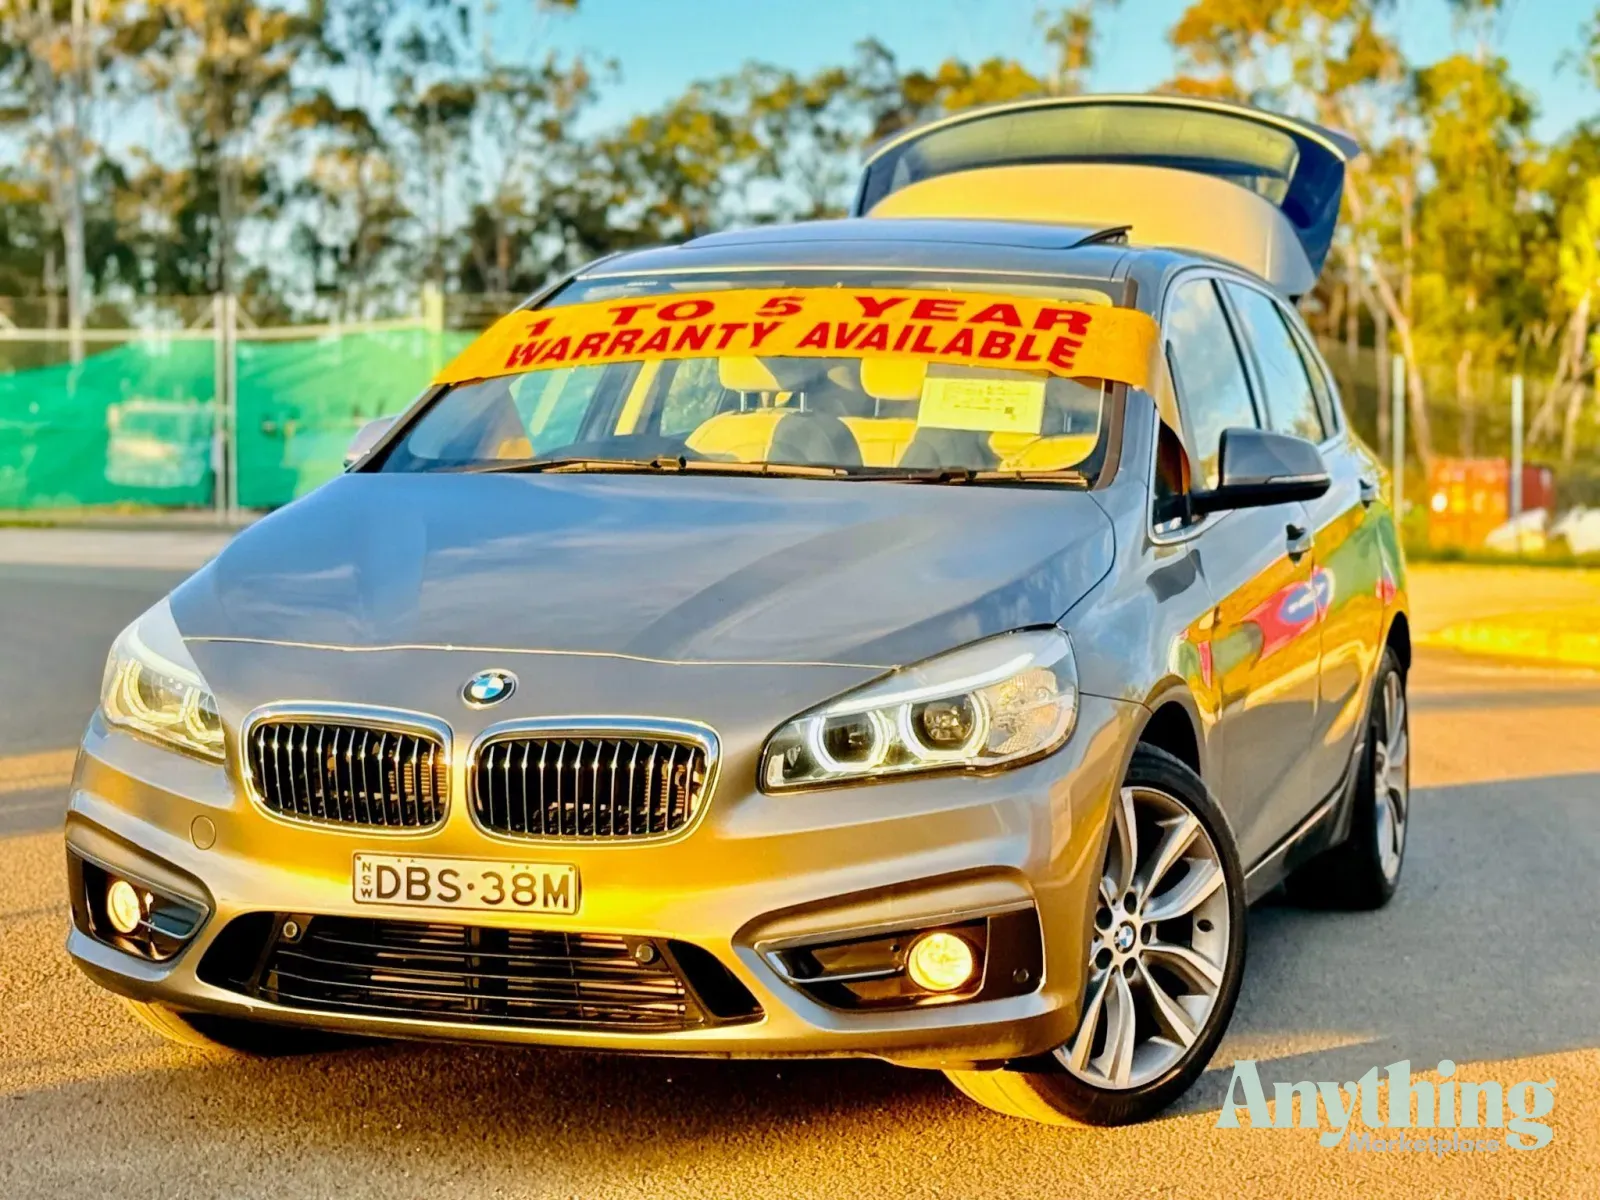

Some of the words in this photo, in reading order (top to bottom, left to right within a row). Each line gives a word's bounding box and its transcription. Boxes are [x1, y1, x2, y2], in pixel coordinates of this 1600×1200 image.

[526, 317, 555, 338] 1
[608, 299, 715, 326] TO
[755, 296, 806, 317] 5
[853, 296, 1093, 336] YEAR
[503, 321, 785, 369] WARRANTY
[795, 321, 1084, 370] AVAILABLE
[360, 861, 373, 899] NSW
